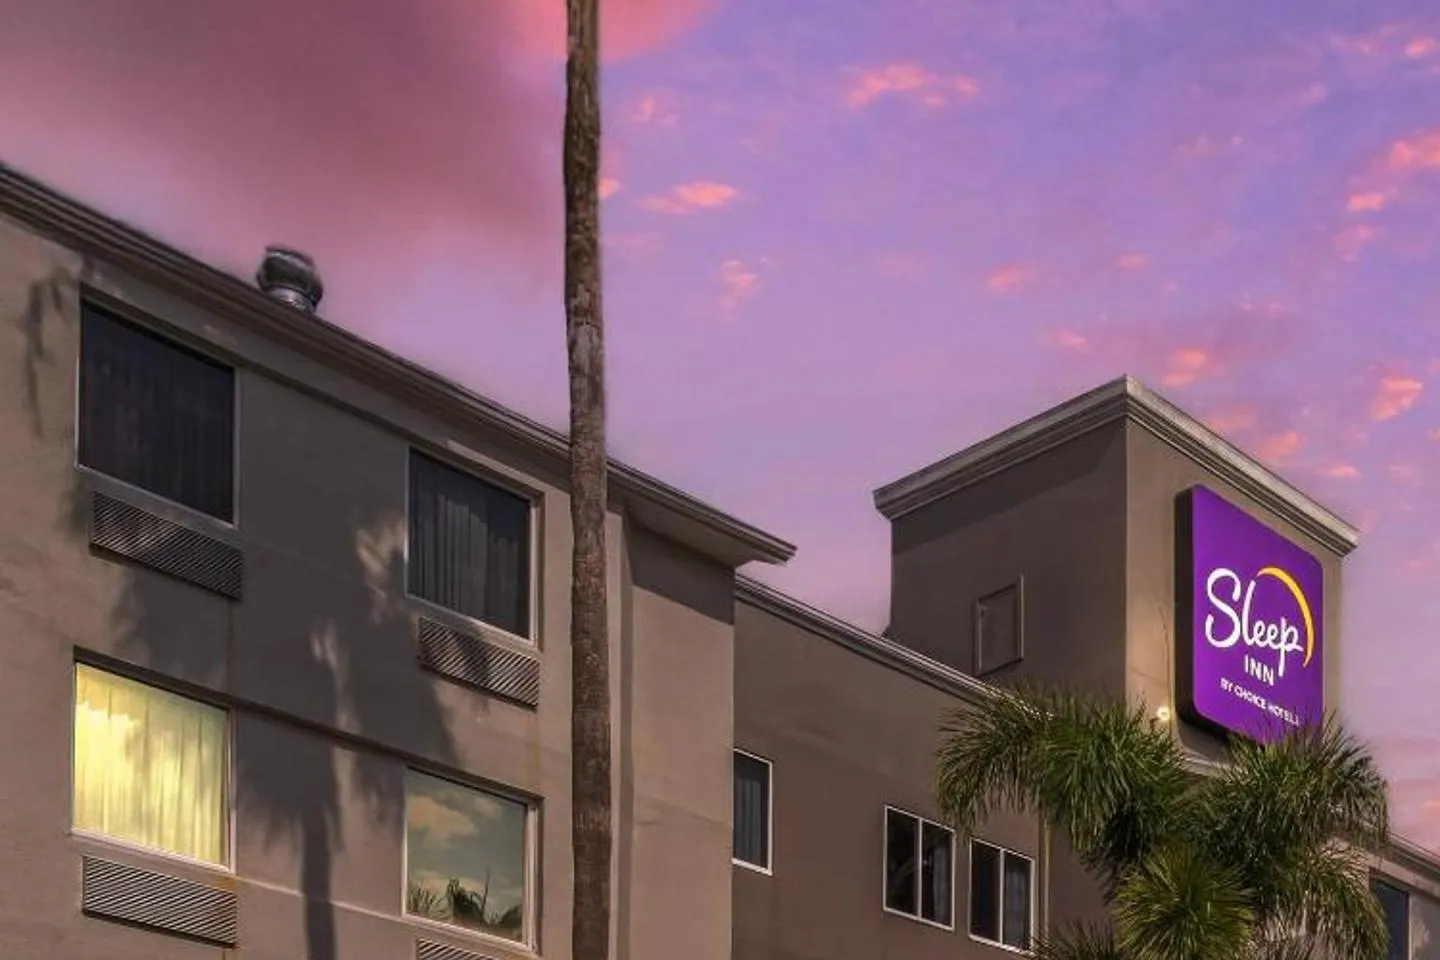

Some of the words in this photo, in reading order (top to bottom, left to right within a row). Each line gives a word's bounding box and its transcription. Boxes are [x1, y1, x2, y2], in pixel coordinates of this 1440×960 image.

[1205, 567, 1304, 677] Sleep
[1244, 654, 1274, 686] INN
[1220, 677, 1233, 692] BY
[1234, 685, 1266, 709] CHOICE
